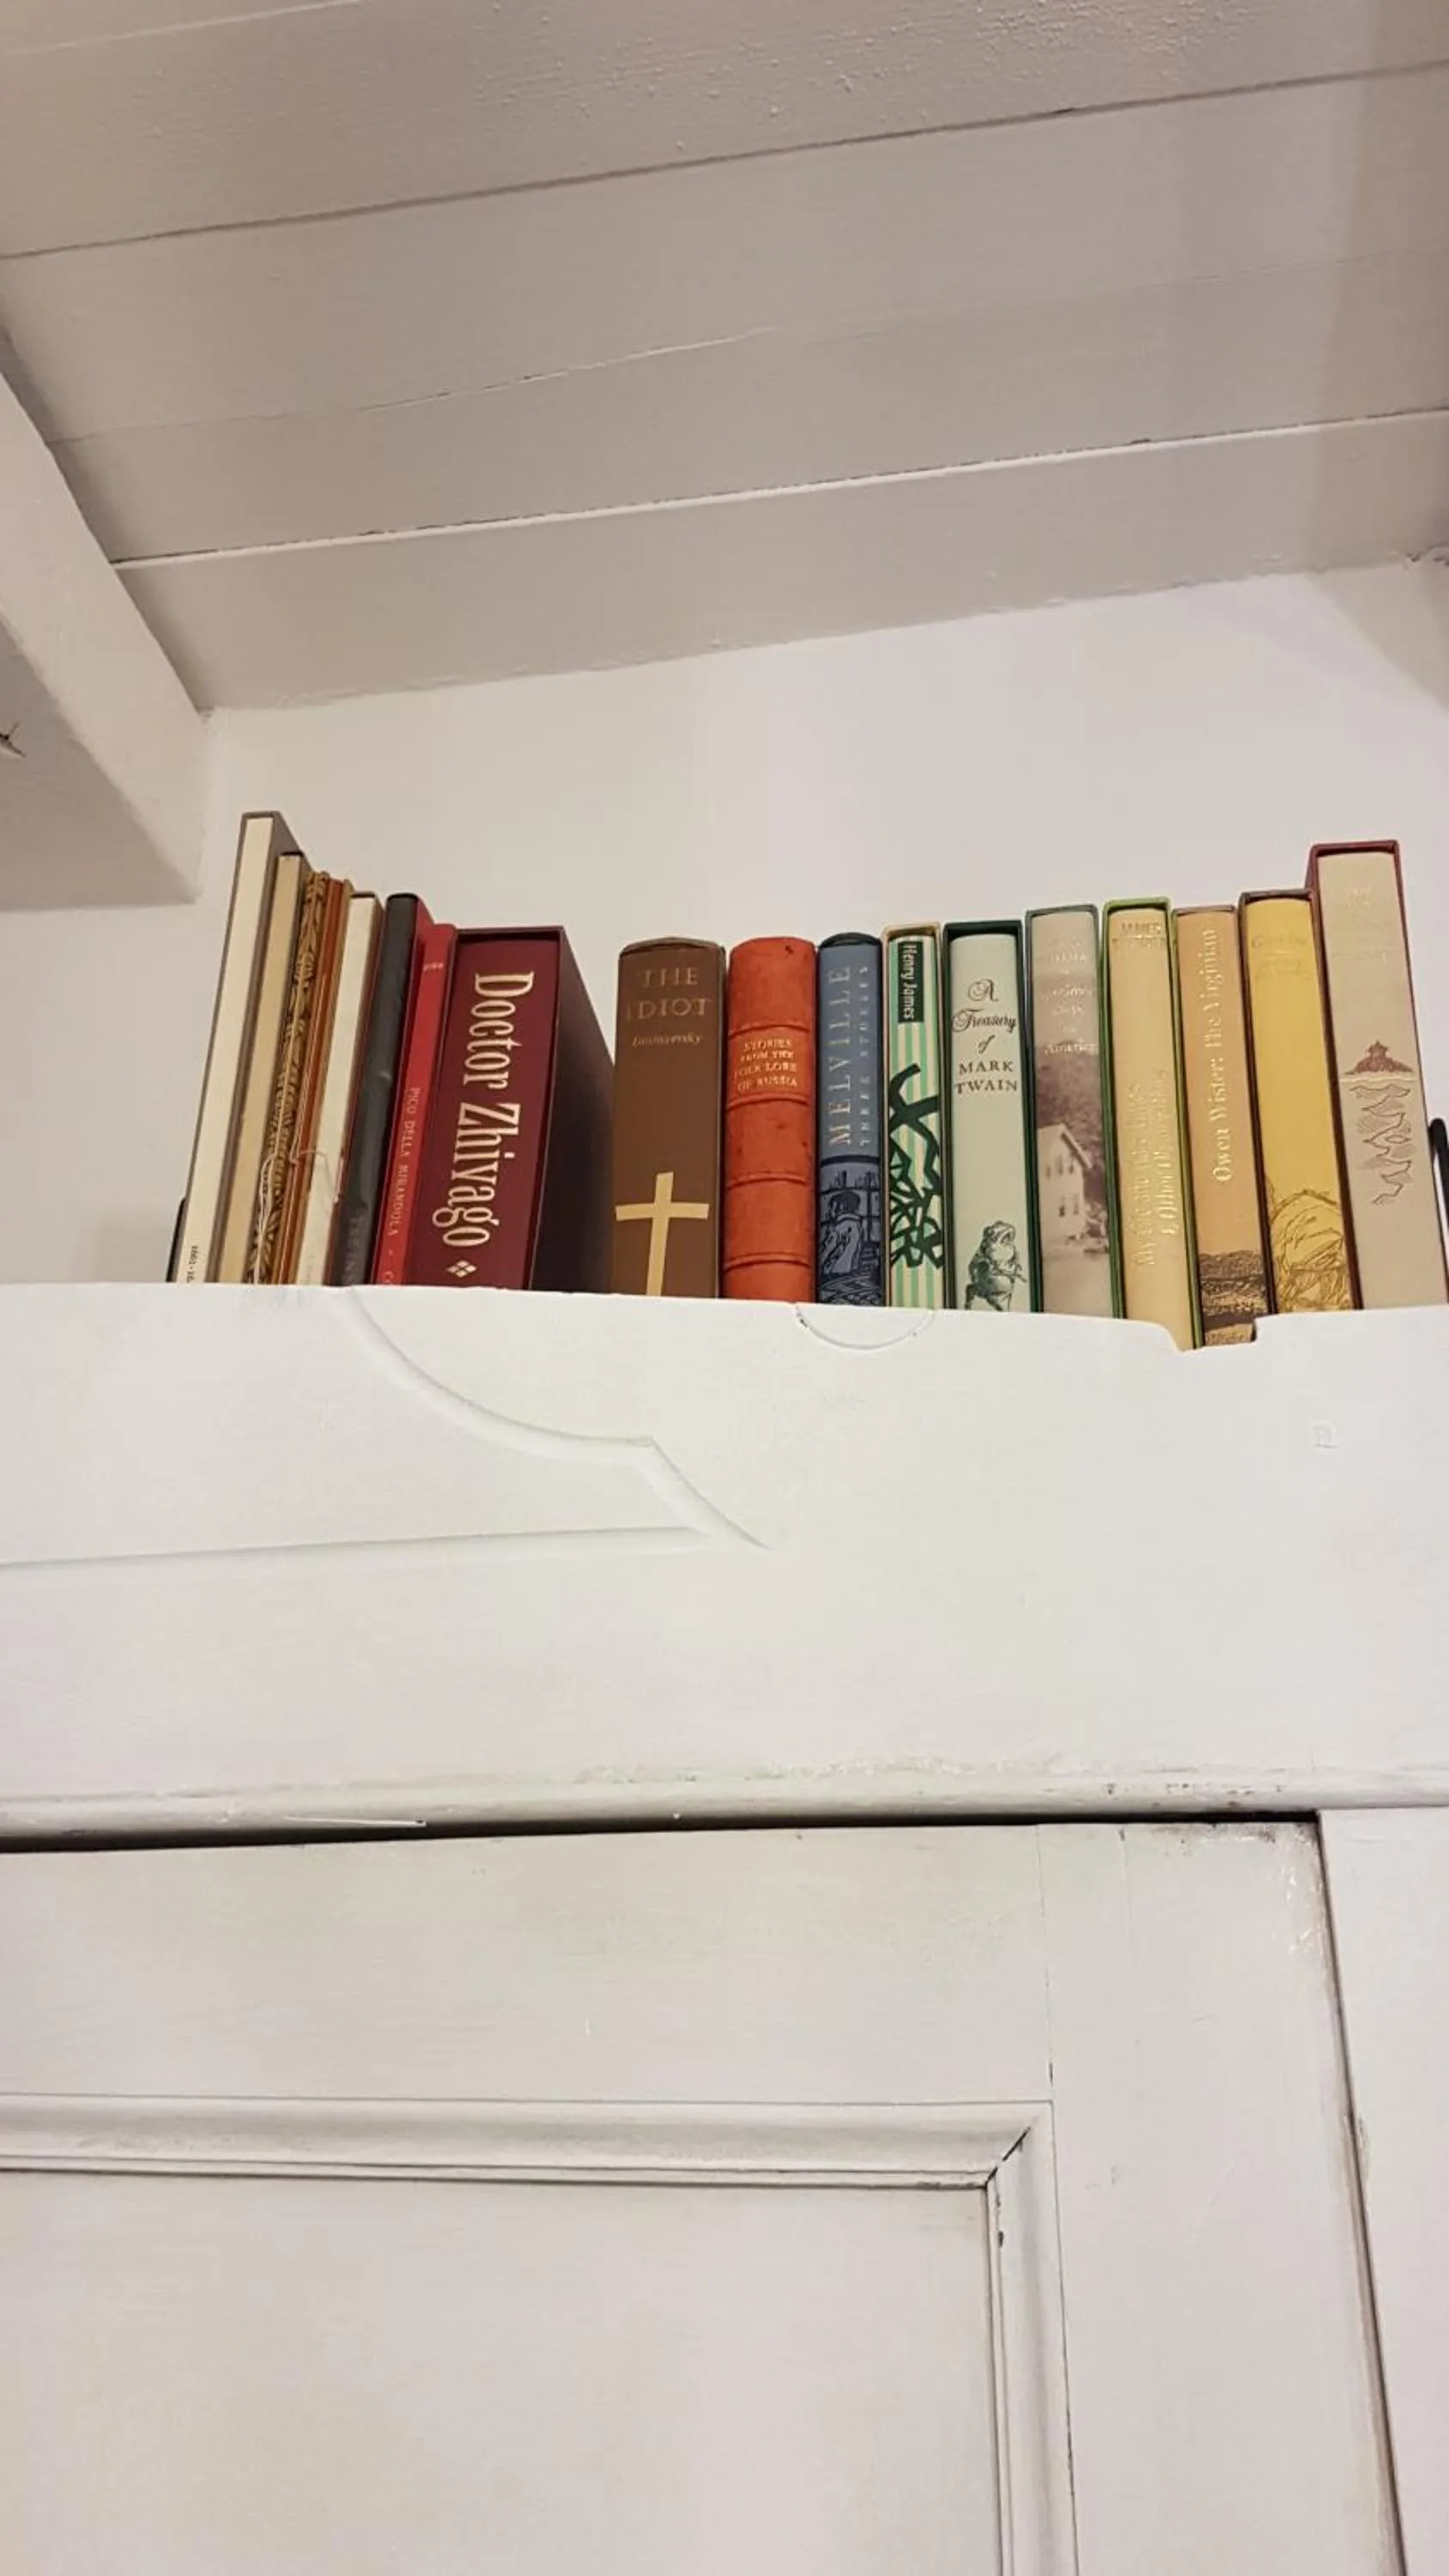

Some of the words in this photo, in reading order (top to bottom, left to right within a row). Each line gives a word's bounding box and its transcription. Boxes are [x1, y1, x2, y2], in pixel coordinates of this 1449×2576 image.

[900, 944, 918, 980] Henry
[1198, 929, 1224, 1011] Virginian
[637, 967, 699, 988] THE
[967, 978, 999, 1003] A
[627, 996, 714, 1023] IDIOT
[902, 982, 918, 1020] James
[464, 971, 536, 1090] Doctor
[951, 1007, 1017, 1034] Treasury
[1204, 1018, 1224, 1048] The
[771, 1049, 795, 1060] THE
[828, 967, 852, 1146] MELVILLE
[977, 1034, 997, 1054] of
[765, 1060, 798, 1073] LORE
[958, 1060, 1015, 1076] MARK
[407, 1087, 421, 1115] PICO
[955, 1078, 1018, 1096] TWAIN
[1209, 1056, 1227, 1122] Wister:
[401, 1120, 415, 1157] DELLA
[1212, 1127, 1233, 1182] Owen
[433, 1102, 521, 1248] Zhivago
